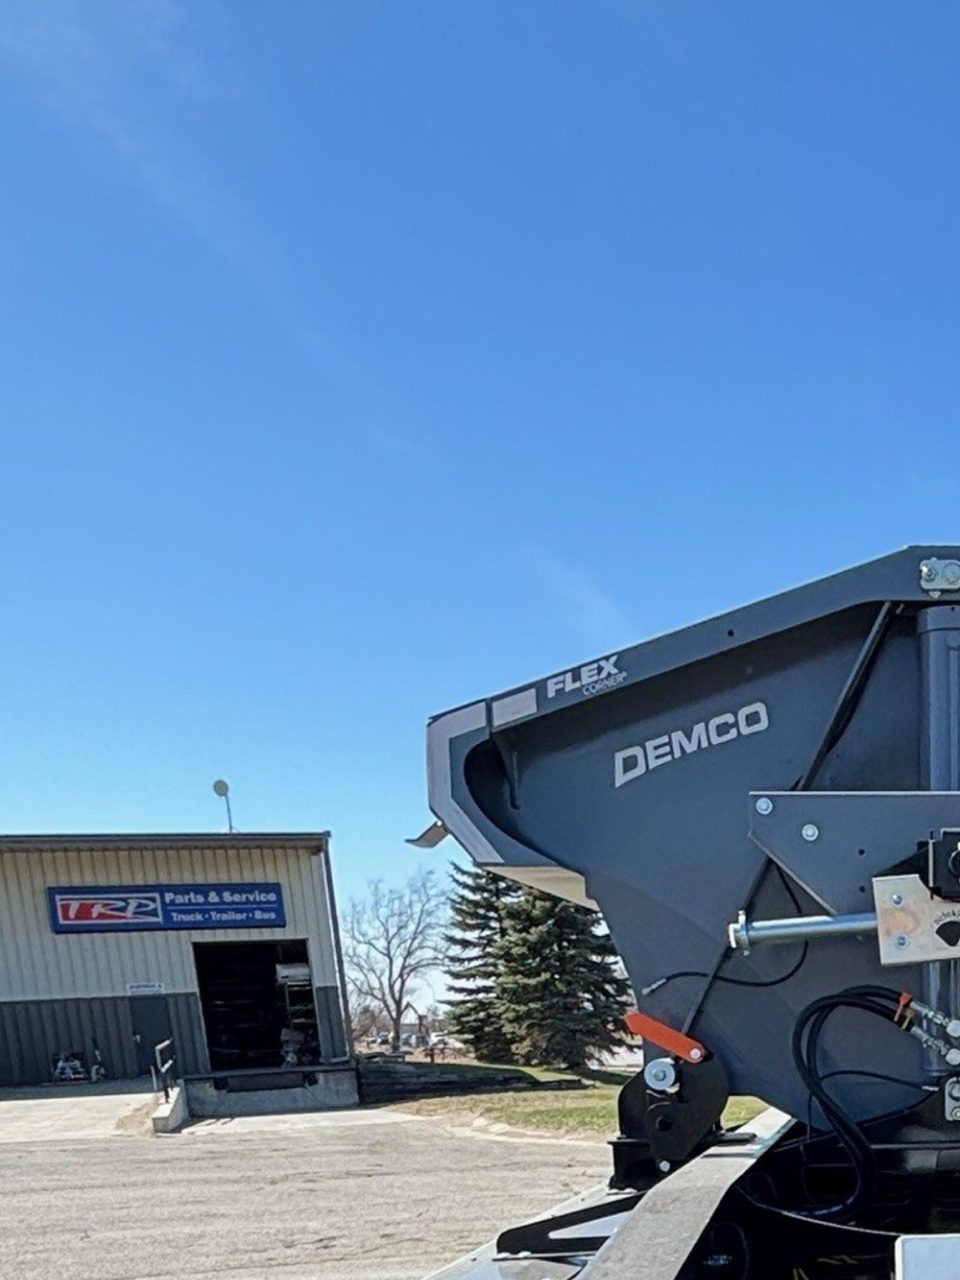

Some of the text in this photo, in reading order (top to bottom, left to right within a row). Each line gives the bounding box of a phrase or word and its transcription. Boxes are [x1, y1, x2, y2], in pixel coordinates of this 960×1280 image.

[546, 654, 620, 699] FLEX
[614, 702, 769, 788] DEMCO
[164, 890, 277, 904] Parts & Service
[171, 910, 276, 922] Truck Trailer Bus
